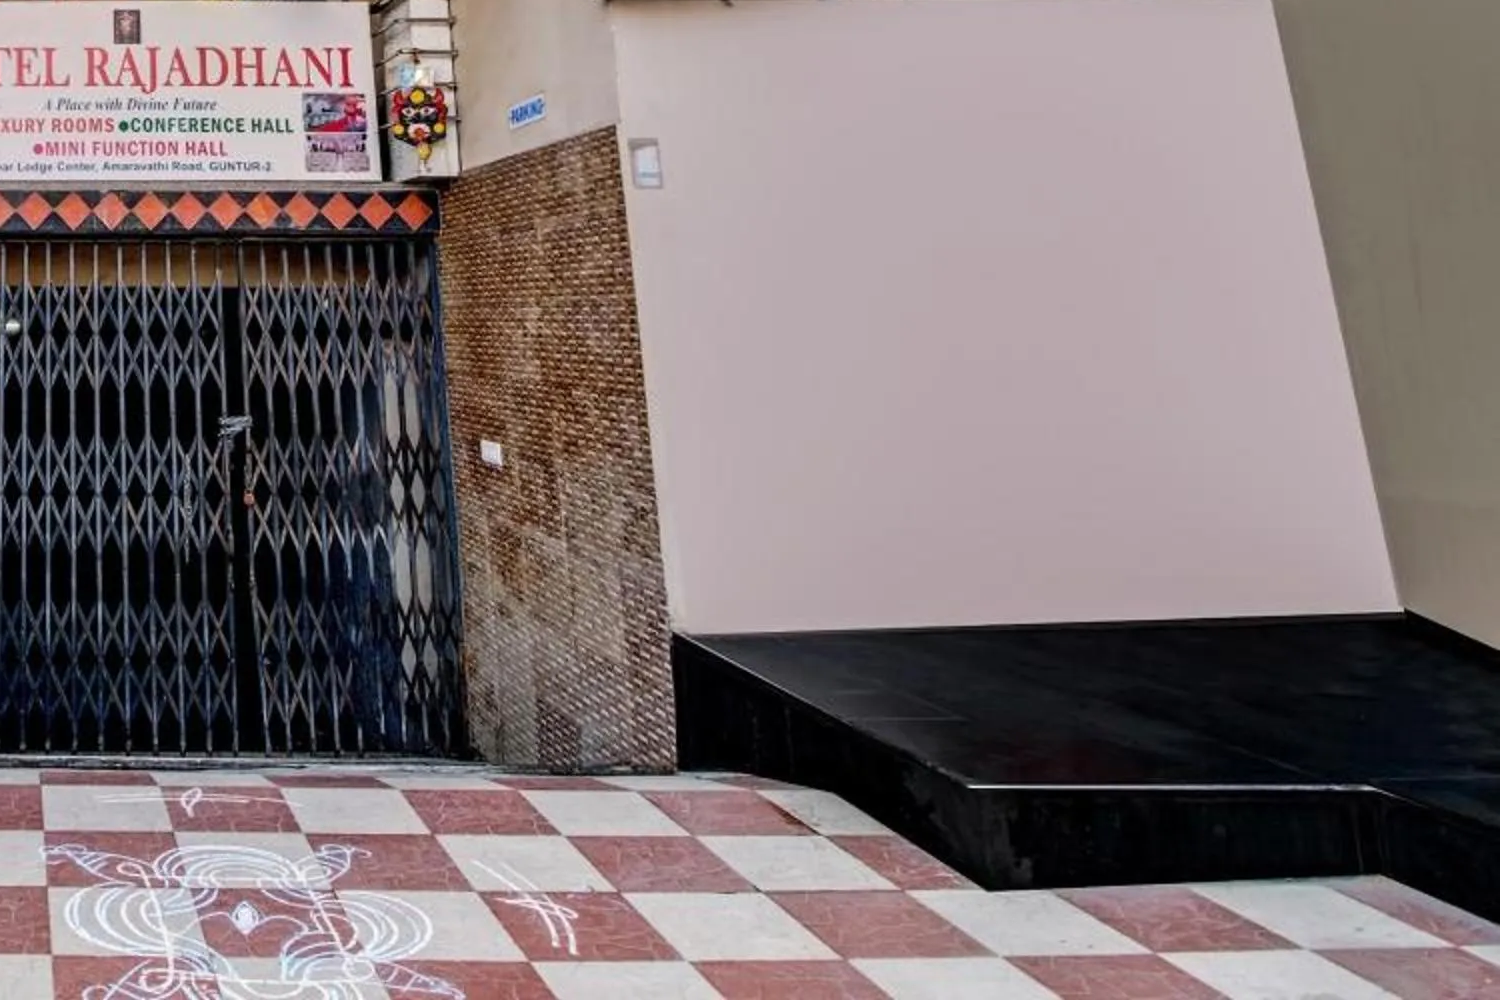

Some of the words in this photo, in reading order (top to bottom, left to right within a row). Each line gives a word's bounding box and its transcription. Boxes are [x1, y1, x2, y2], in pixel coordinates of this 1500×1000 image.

[84, 46, 354, 95] RAJADHANI
[56, 98, 91, 111] Place
[95, 97, 122, 111] with
[127, 97, 169, 111] Divine
[173, 97, 218, 111] Future
[51, 118, 115, 133] ROOMS
[130, 118, 246, 133] CONFERENCE
[251, 118, 295, 133] HALL
[45, 141, 86, 157] MINI
[92, 141, 179, 157] FUNCTION
[185, 141, 229, 157] HALL
[17, 162, 53, 174] Lodge
[102, 161, 169, 172] Amaravathi
